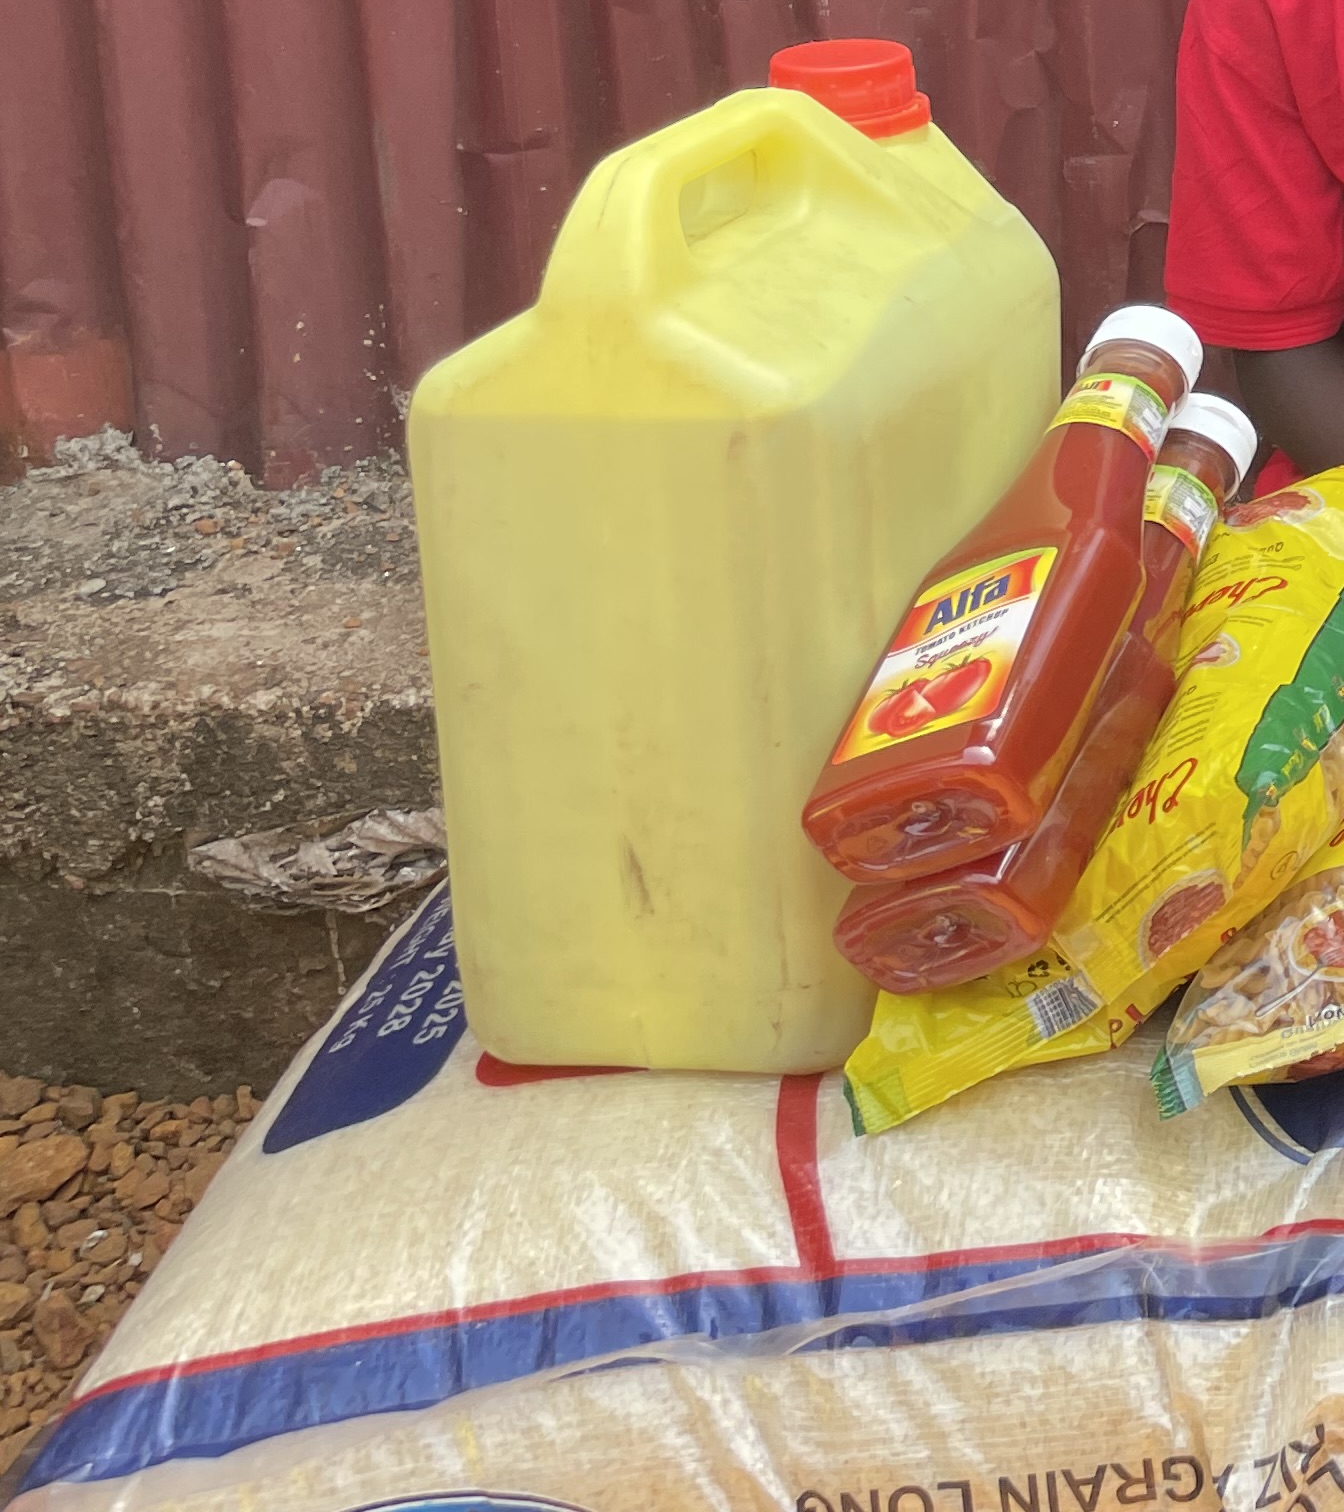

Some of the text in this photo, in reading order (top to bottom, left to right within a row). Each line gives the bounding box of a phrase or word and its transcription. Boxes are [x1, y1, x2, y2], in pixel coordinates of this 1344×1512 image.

[915, 608, 1009, 656] TOMATO KETCHUP
[924, 574, 1011, 635] Alfa
[358, 984, 393, 1015] 25
[376, 964, 446, 1038] 2028
[998, 1454, 1204, 1512] GRAIN
